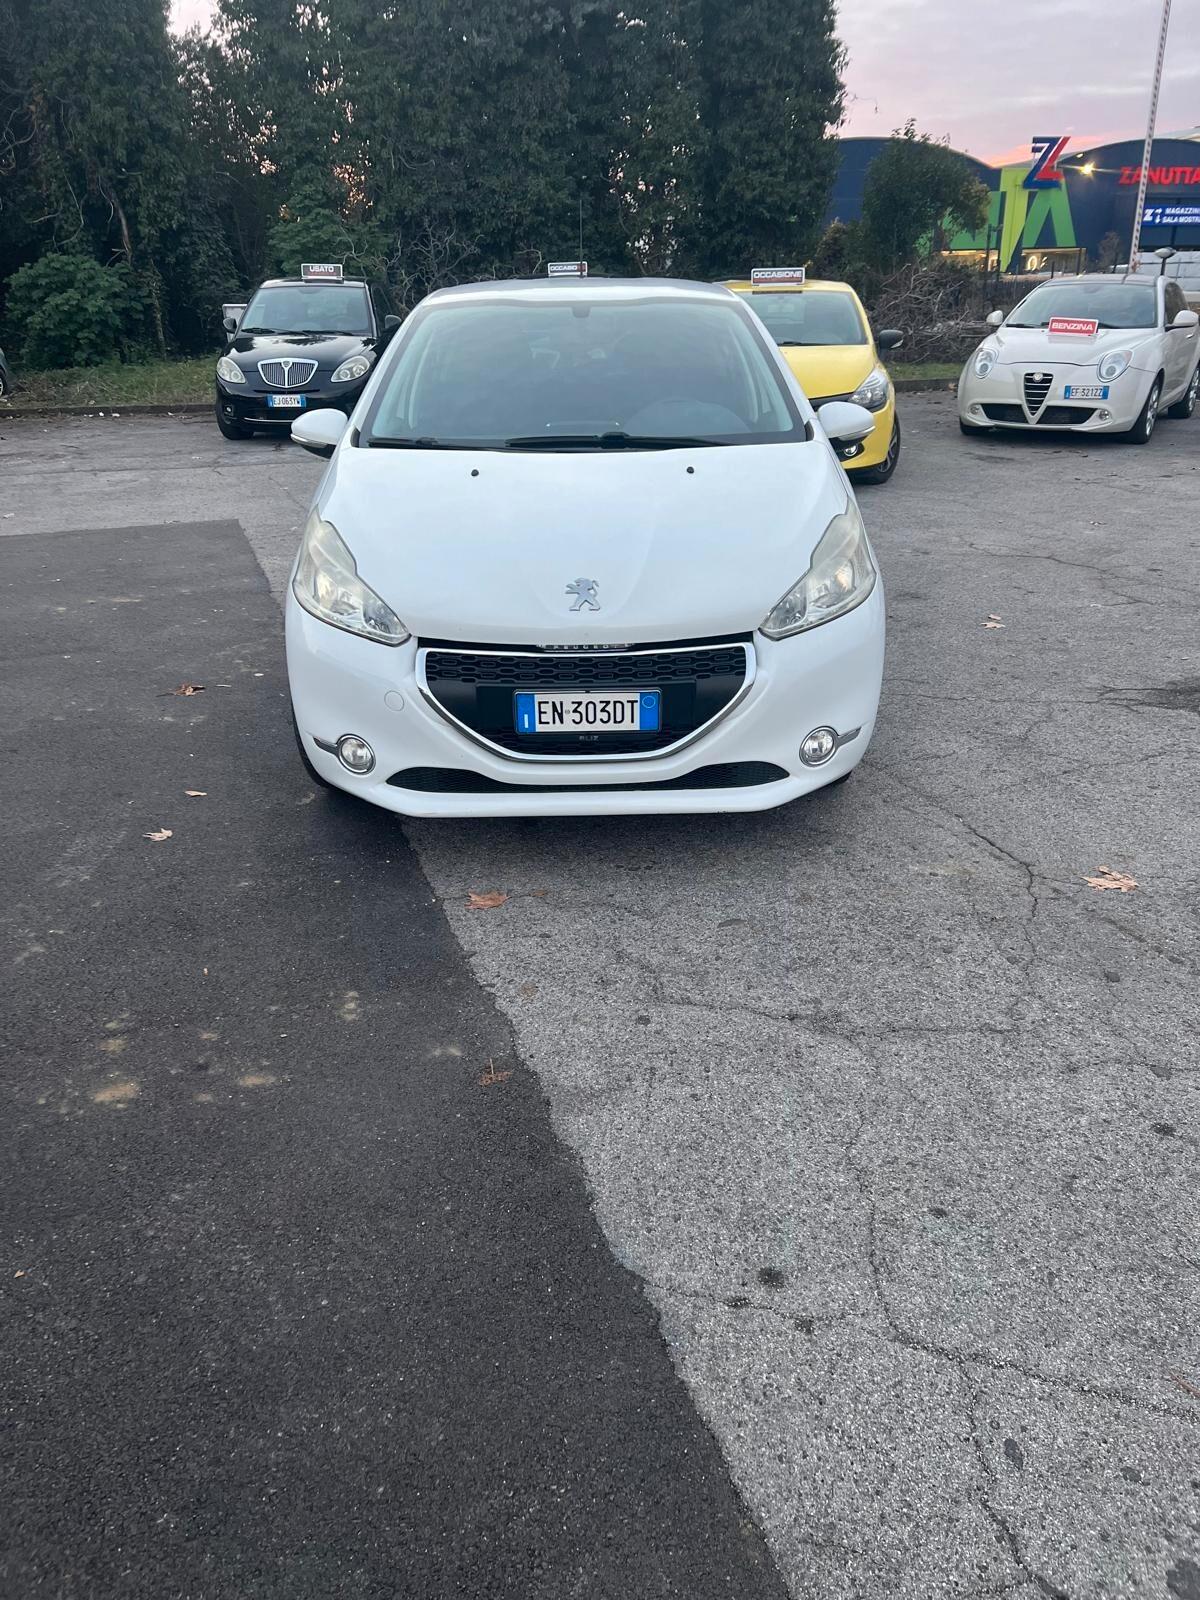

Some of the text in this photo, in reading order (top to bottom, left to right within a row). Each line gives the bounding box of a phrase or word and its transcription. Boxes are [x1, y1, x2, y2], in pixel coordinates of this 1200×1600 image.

[309, 265, 334, 273] USATO
[753, 271, 802, 279] OCCASIONE
[1052, 322, 1094, 331] BENZINA
[537, 699, 639, 725] EN 303DT
